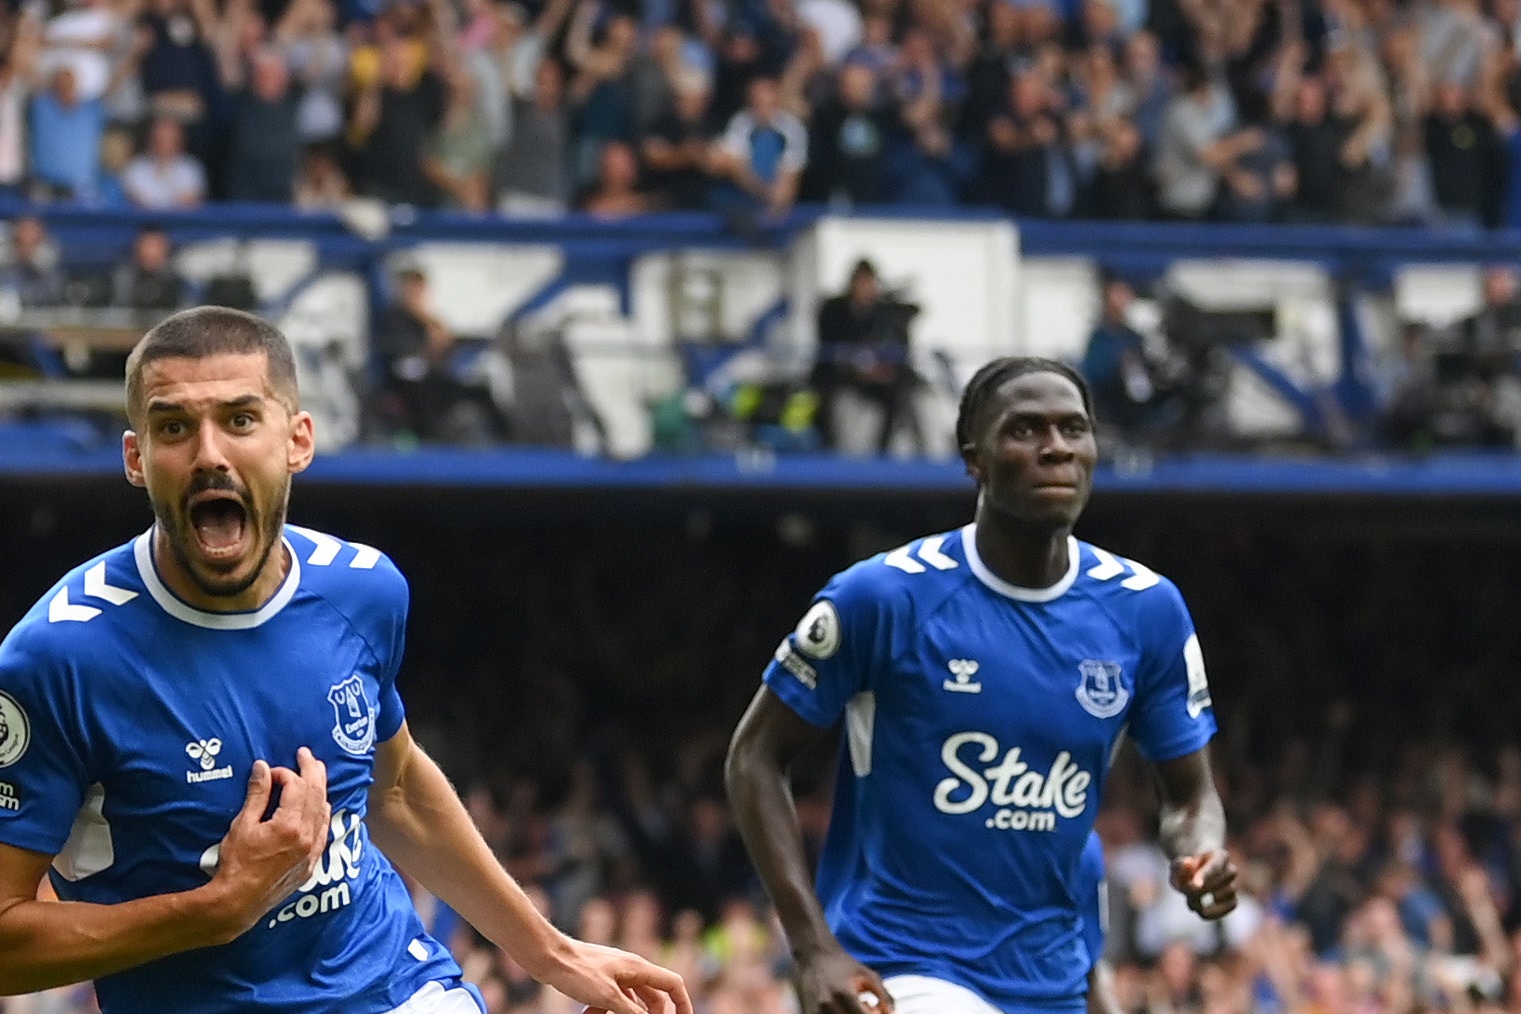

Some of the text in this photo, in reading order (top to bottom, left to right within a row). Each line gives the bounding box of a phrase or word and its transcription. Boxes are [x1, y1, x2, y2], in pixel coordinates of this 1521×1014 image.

[933, 731, 1091, 818] Stake
[985, 808, 1056, 832] .com
[269, 881, 350, 929] .com
